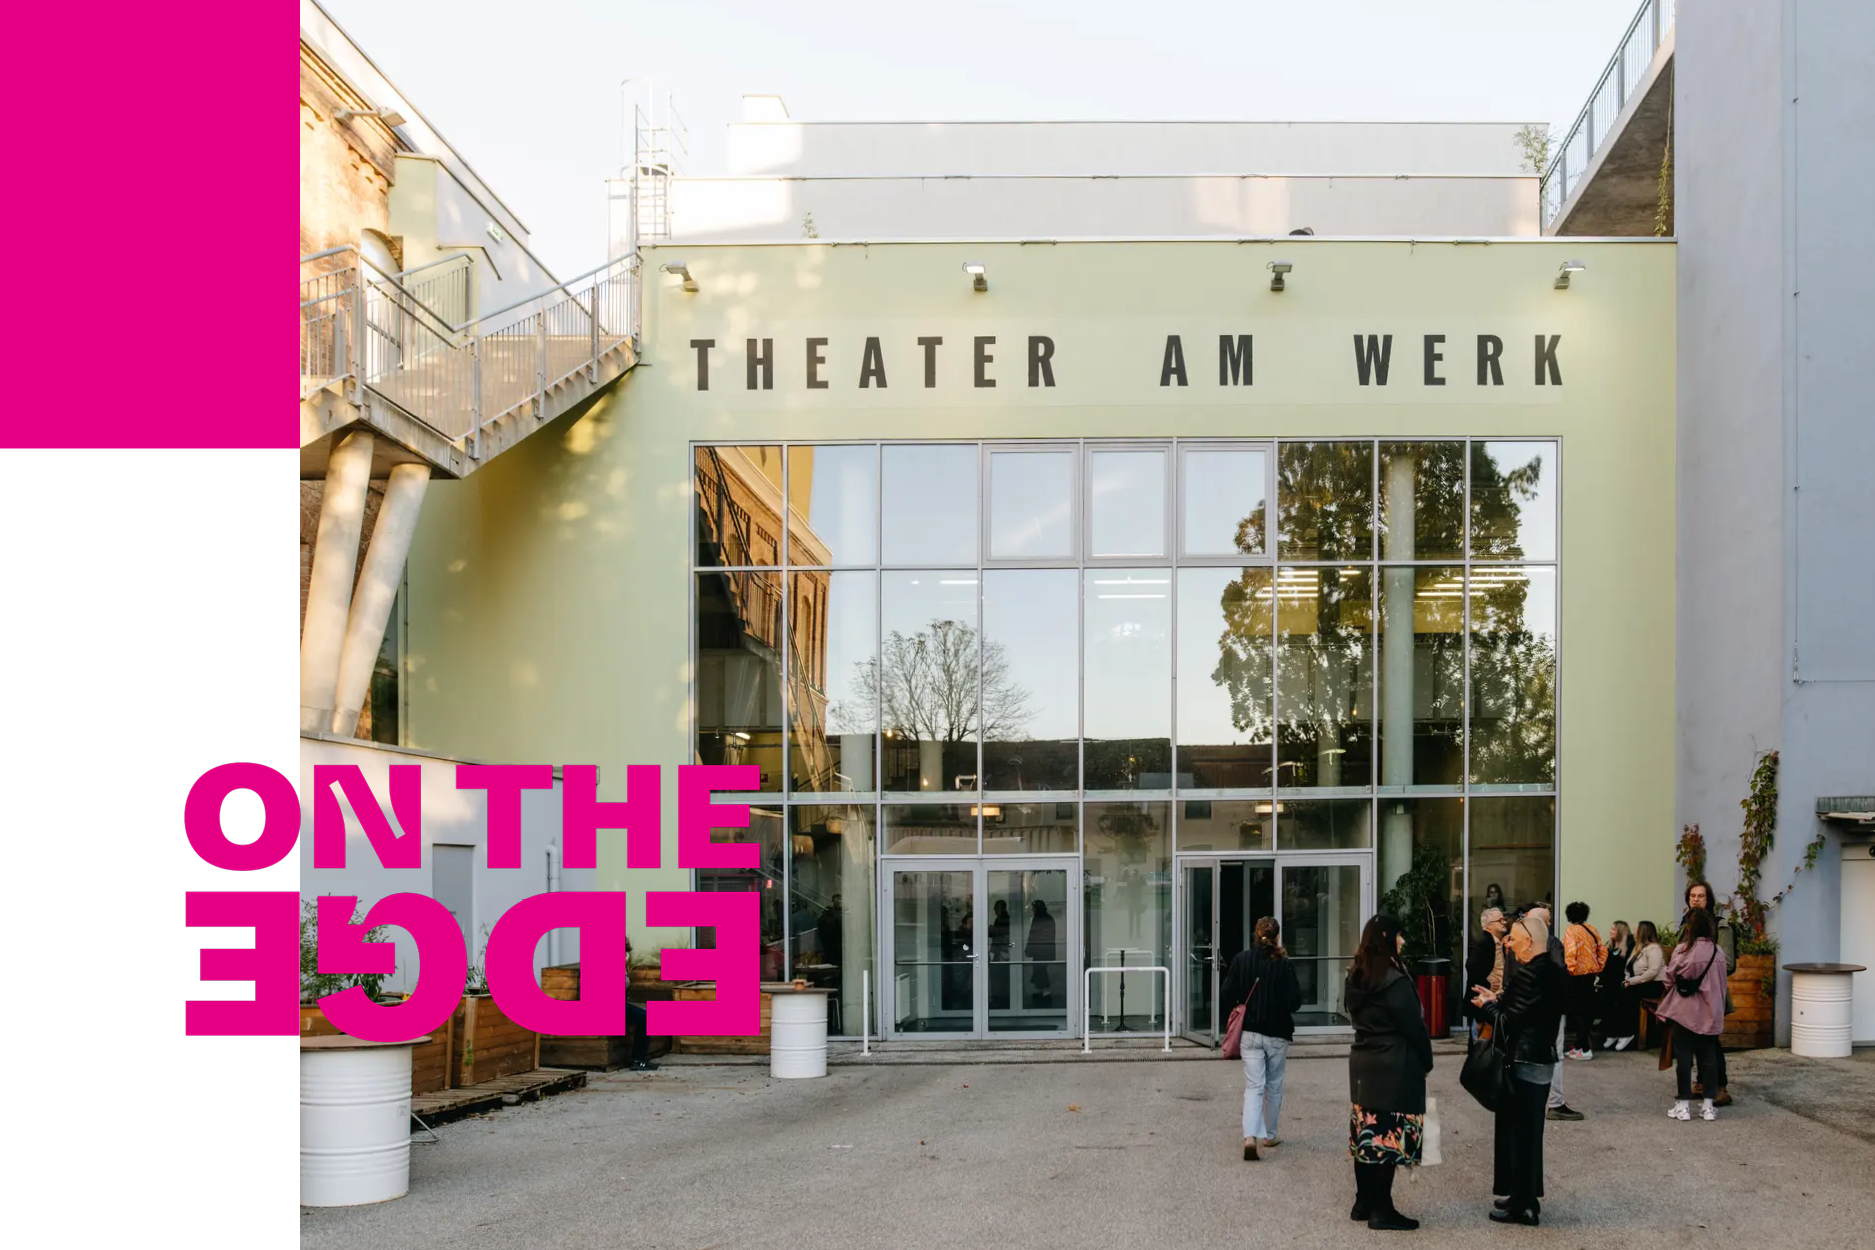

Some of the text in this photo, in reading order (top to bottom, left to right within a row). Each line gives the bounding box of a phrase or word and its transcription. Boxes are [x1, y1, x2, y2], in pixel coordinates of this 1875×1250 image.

[690, 334, 1563, 391] THEATER AM WERK
